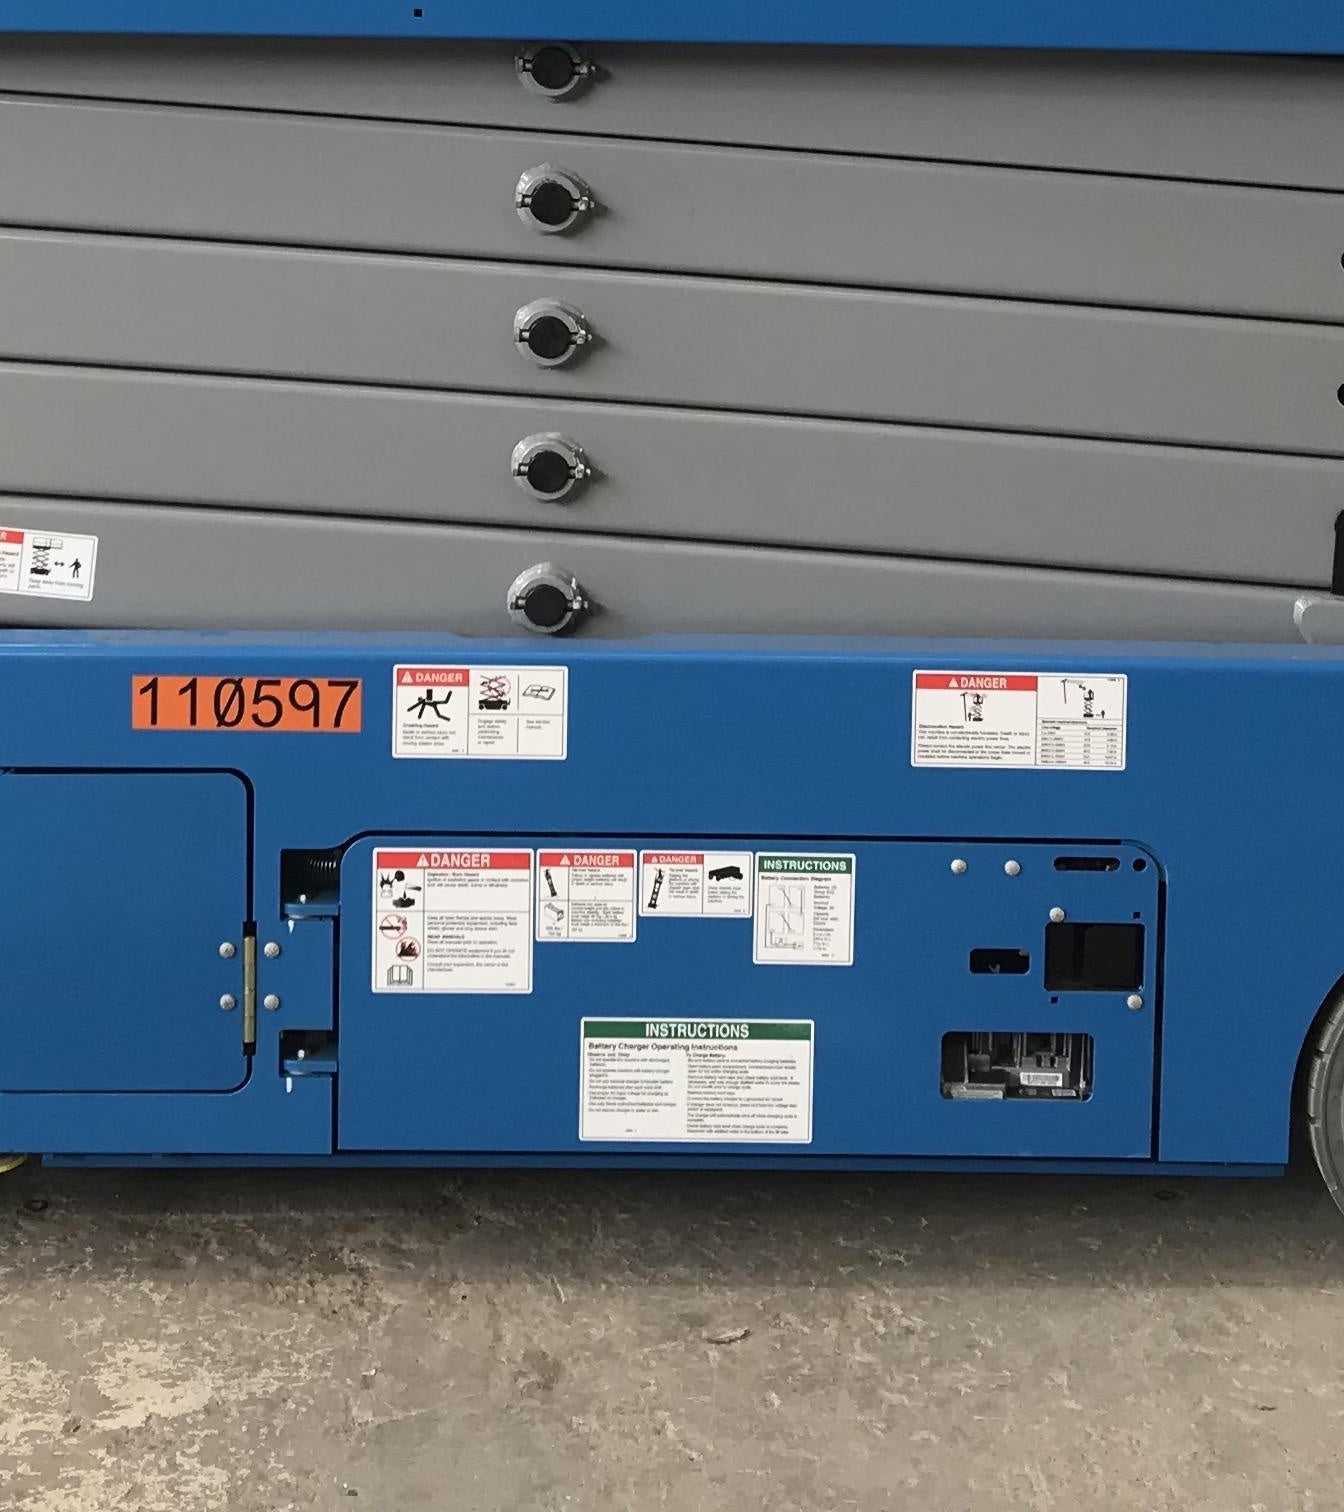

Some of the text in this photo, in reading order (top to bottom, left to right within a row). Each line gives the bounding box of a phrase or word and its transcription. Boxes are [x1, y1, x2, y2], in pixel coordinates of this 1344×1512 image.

[415, 672, 463, 683] DANGER
[960, 677, 1008, 689] DANGER
[139, 677, 359, 728] 110597
[430, 853, 491, 868] DANGER
[573, 854, 620, 866] DANGER
[659, 855, 697, 864] DANGER
[763, 859, 847, 871] INSTRUCTIONS
[645, 1023, 750, 1038] INSTRUCTIONS
[588, 1042, 617, 1051] Battery
